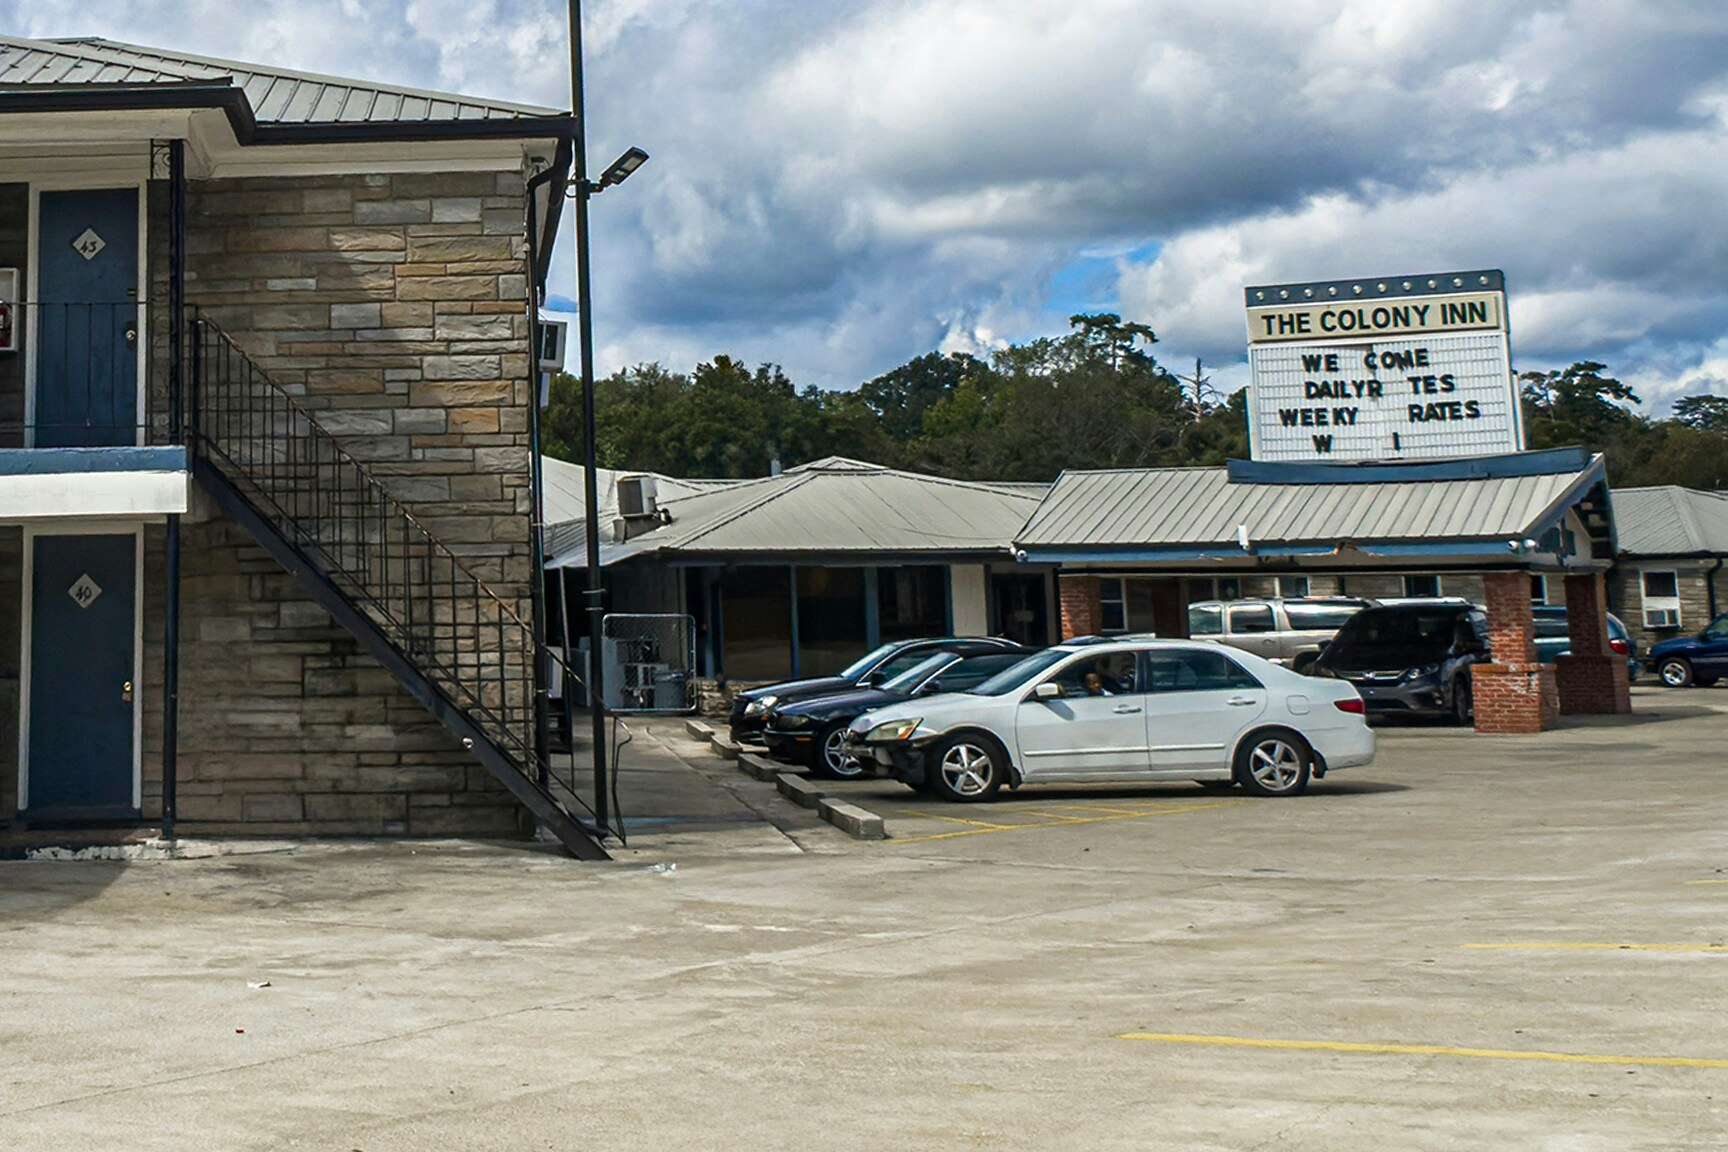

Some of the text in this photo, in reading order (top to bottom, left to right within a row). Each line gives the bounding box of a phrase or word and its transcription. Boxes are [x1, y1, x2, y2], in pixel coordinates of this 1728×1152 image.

[1261, 301, 1487, 335] THE COLONY INN
[1408, 400, 1481, 422] RATES
